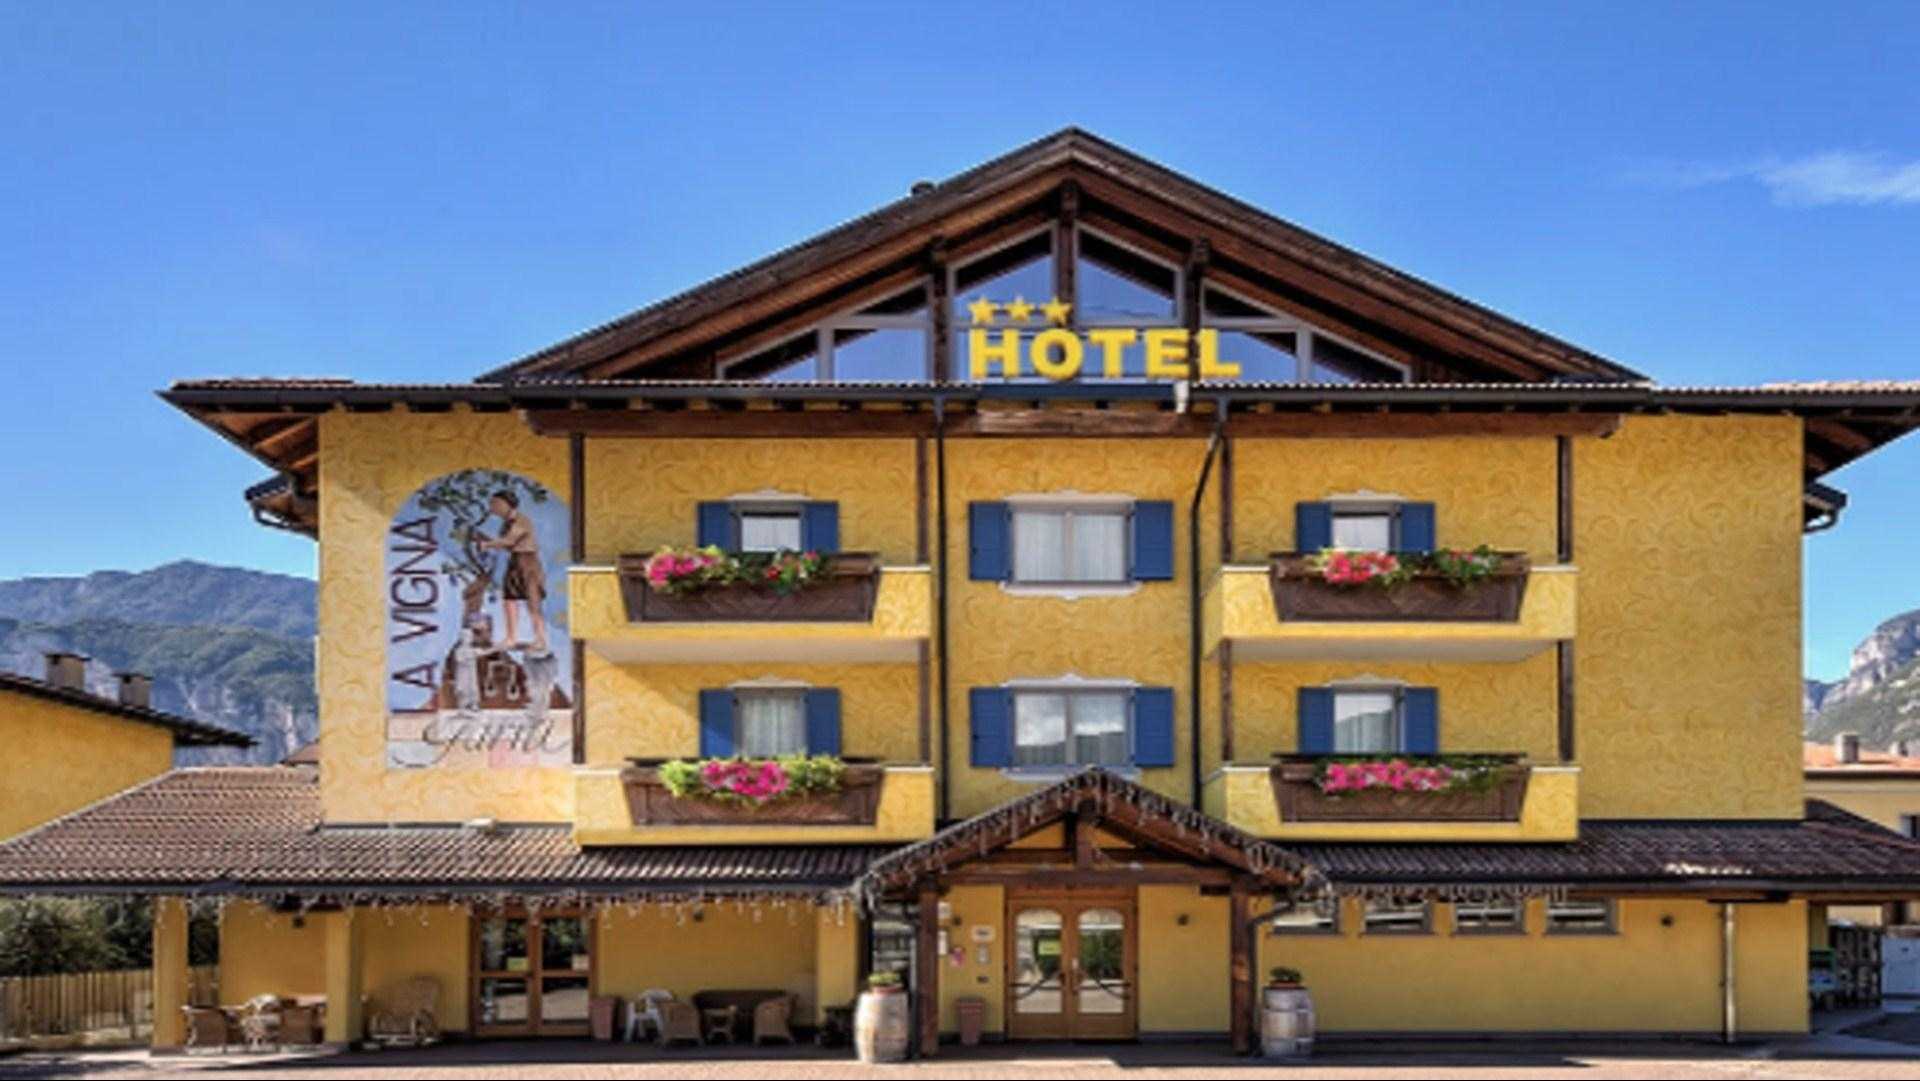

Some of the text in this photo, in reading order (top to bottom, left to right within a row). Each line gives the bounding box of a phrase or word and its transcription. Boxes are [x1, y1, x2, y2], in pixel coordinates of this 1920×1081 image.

[969, 327, 1241, 380] HOTEL
[390, 515, 439, 714] LA VIGNA
